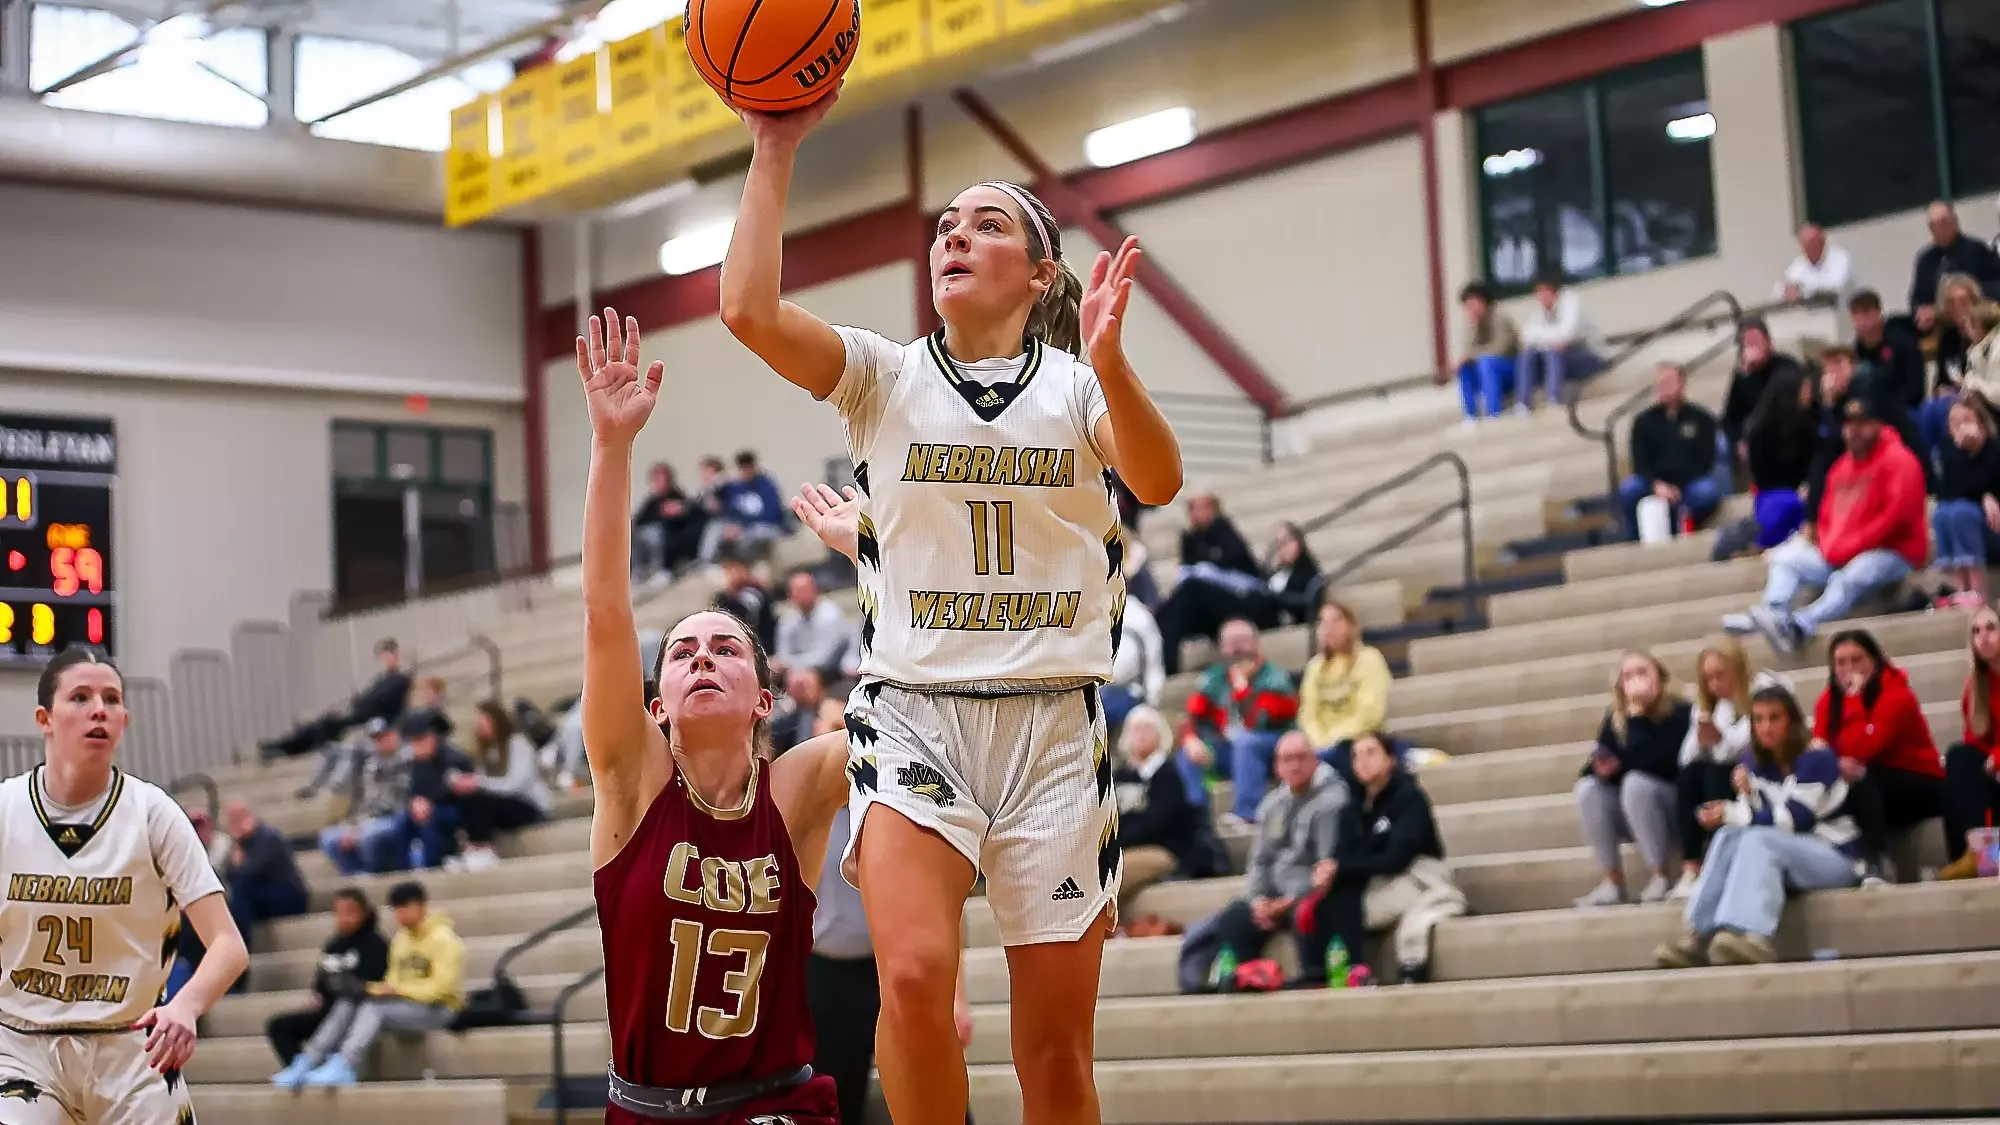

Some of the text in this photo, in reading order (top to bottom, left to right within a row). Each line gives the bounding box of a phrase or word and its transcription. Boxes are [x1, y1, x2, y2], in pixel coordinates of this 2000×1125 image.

[975, 396, 1005, 408] adidas
[900, 443, 1076, 487] NEBRASKA
[964, 500, 1015, 576] 11
[51, 547, 102, 597] 59
[909, 590, 1082, 631] WESLEYAN
[7, 873, 133, 905] NEBRASKA
[663, 842, 782, 914] COE
[1052, 890, 1085, 901] adidas
[37, 914, 93, 966] 24
[10, 967, 131, 1004] WESLEYAN
[665, 918, 771, 1039] 13
